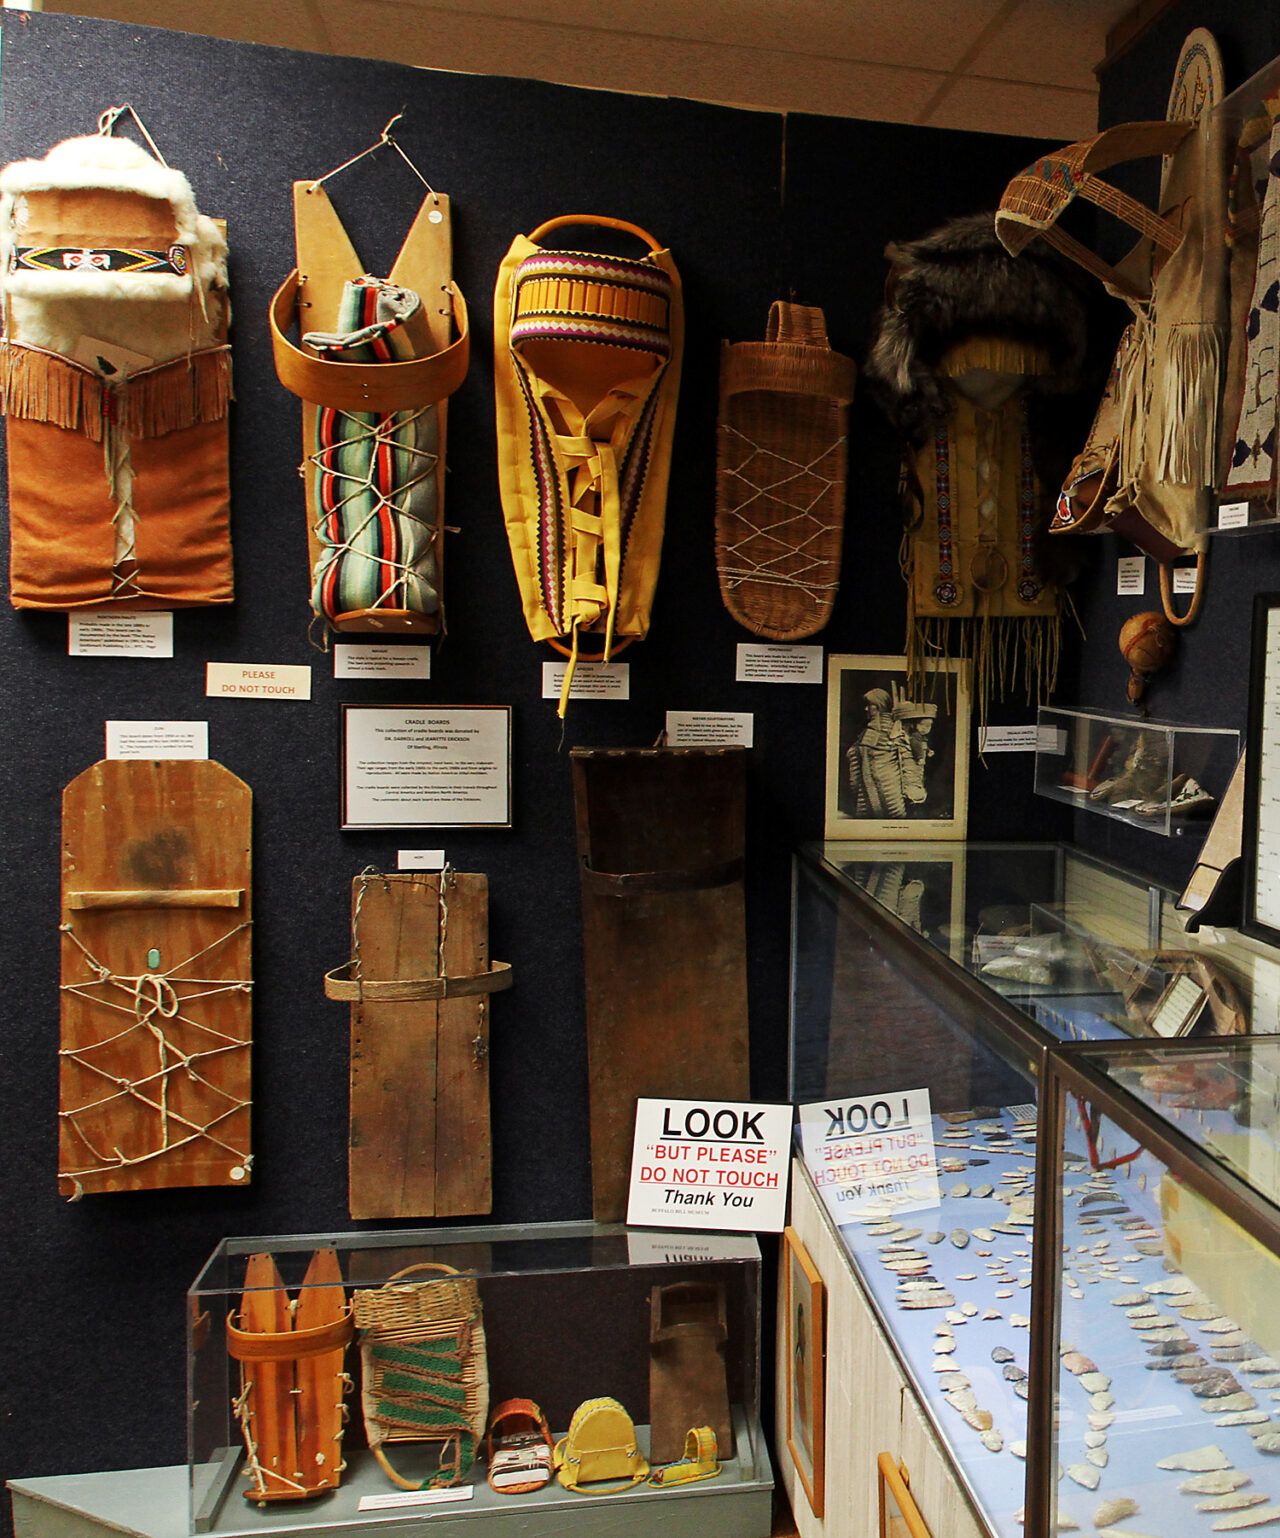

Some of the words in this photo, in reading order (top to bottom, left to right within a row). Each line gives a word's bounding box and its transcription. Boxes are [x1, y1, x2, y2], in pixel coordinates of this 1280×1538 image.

[242, 670, 276, 680] PLEASE
[222, 684, 236, 693] DO
[239, 684, 260, 694] NOT
[262, 685, 295, 695] TOUCH
[662, 1107, 766, 1140] LOOK
[640, 1166, 668, 1182] DO
[673, 1168, 710, 1184] NOT
[718, 1170, 779, 1187] TOUCH
[663, 1189, 716, 1206] Thank
[722, 1192, 753, 1208] You
